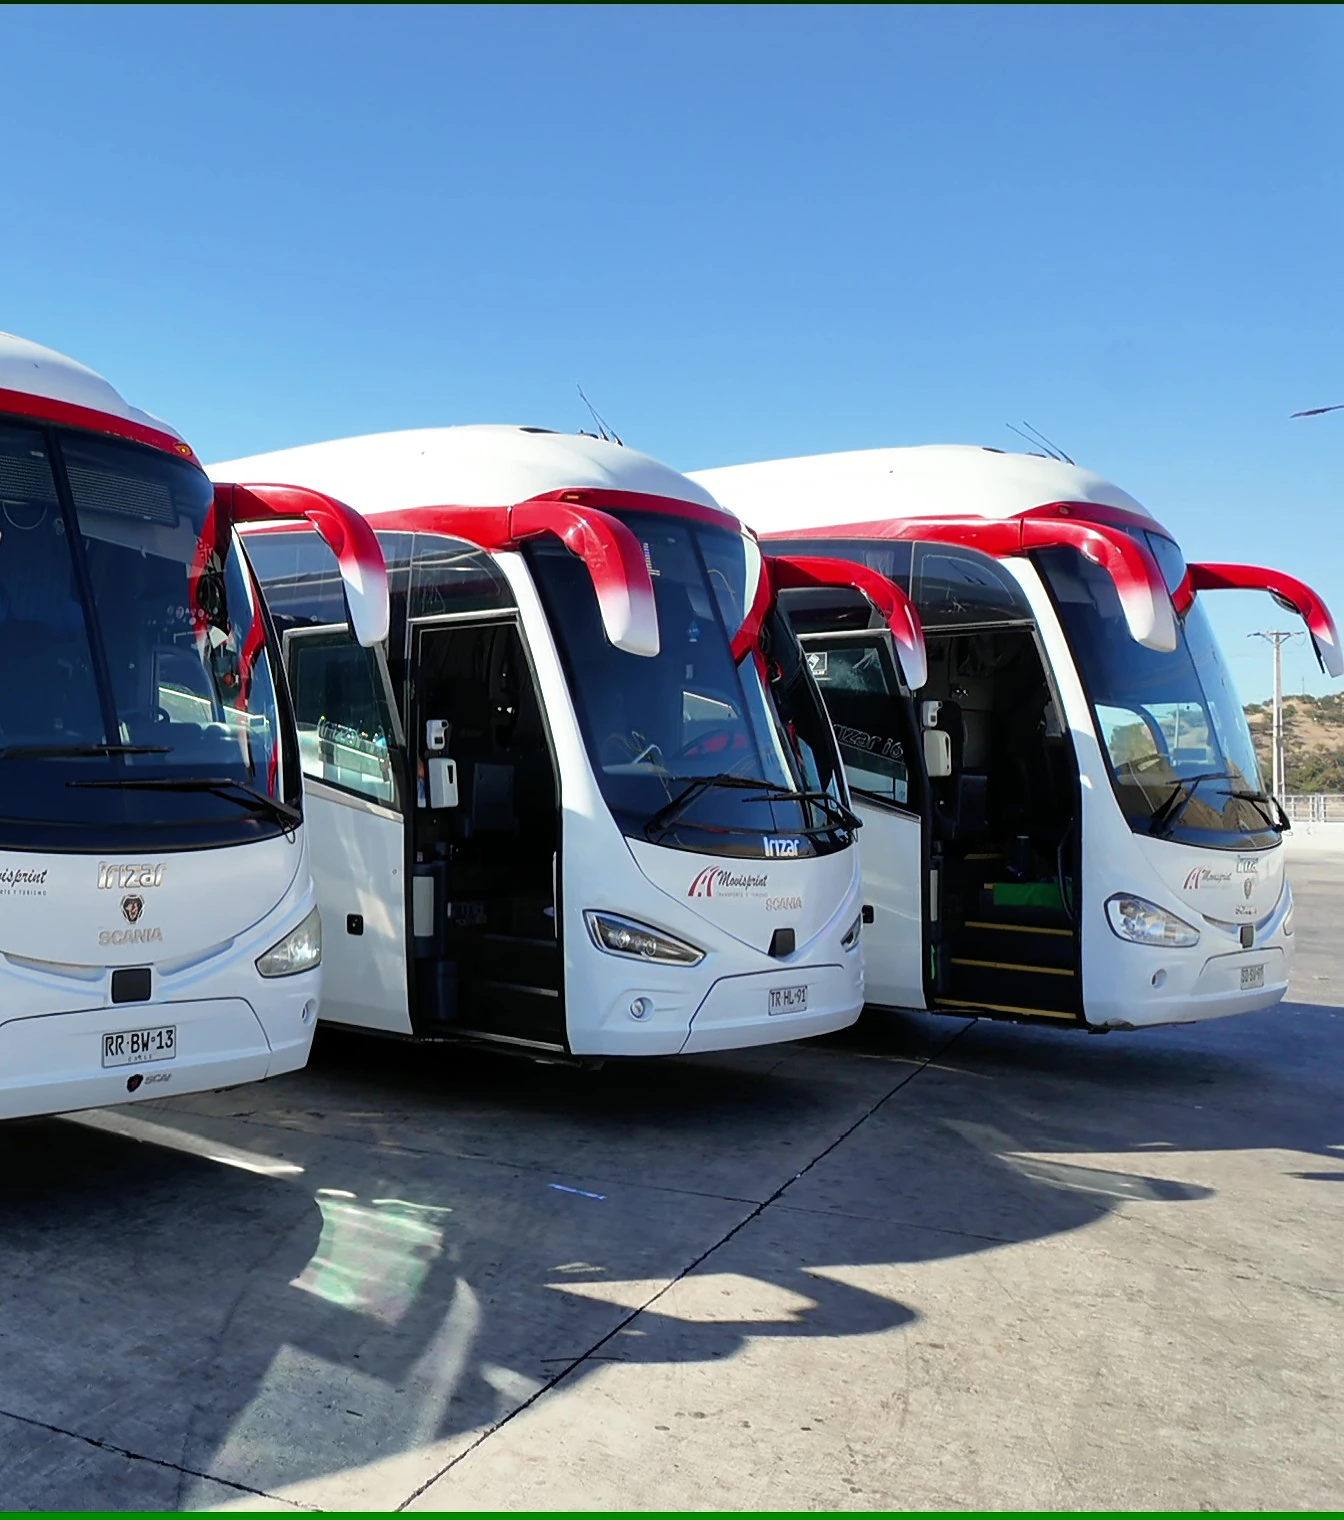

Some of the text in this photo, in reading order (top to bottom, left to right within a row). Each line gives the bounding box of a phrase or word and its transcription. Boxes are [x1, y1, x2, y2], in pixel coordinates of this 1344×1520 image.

[882, 737, 904, 759] i6
[763, 836, 800, 857] Irizar
[97, 861, 167, 889] Irizar
[717, 870, 768, 890] Movisprint
[765, 896, 802, 911] SCANIA
[98, 927, 163, 946] SCANIA
